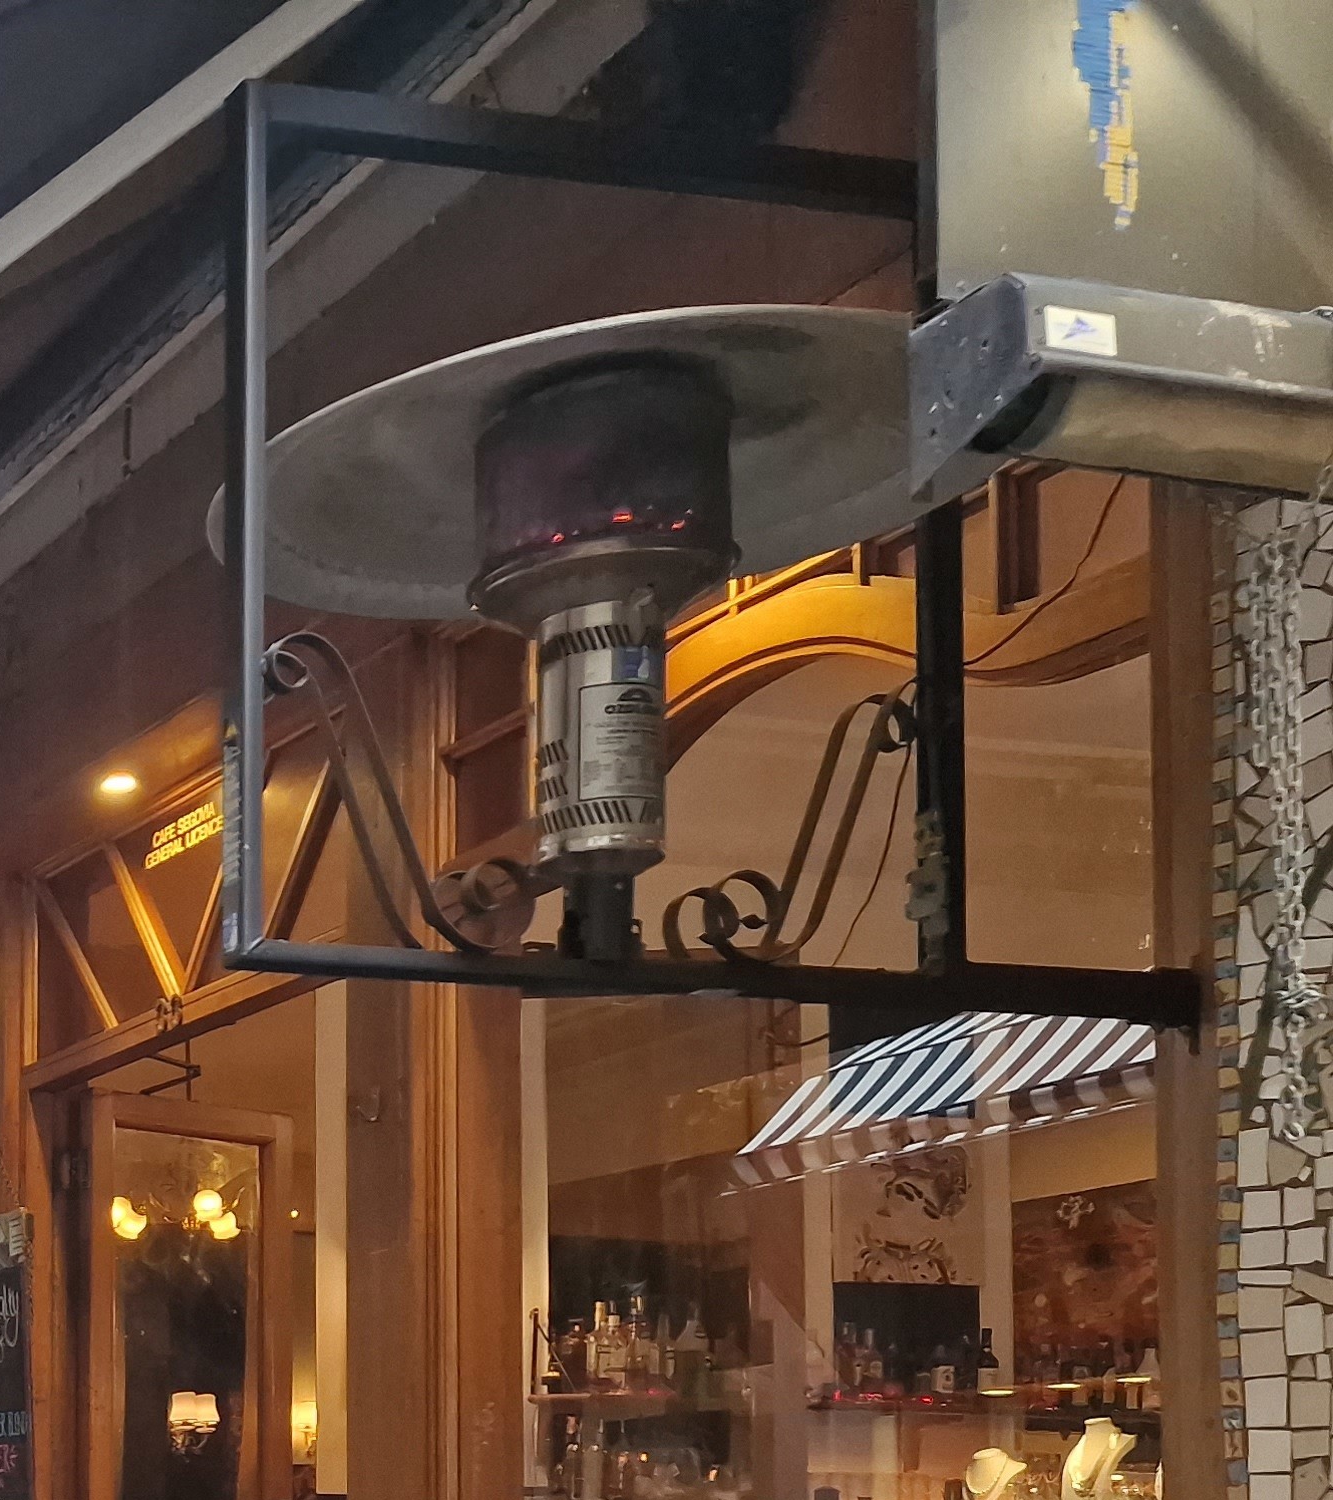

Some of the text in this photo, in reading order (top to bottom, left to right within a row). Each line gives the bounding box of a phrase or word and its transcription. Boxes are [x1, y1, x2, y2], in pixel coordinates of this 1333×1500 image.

[145, 815, 224, 869] GENERAL LICENCE
[153, 822, 177, 848] CAFE
